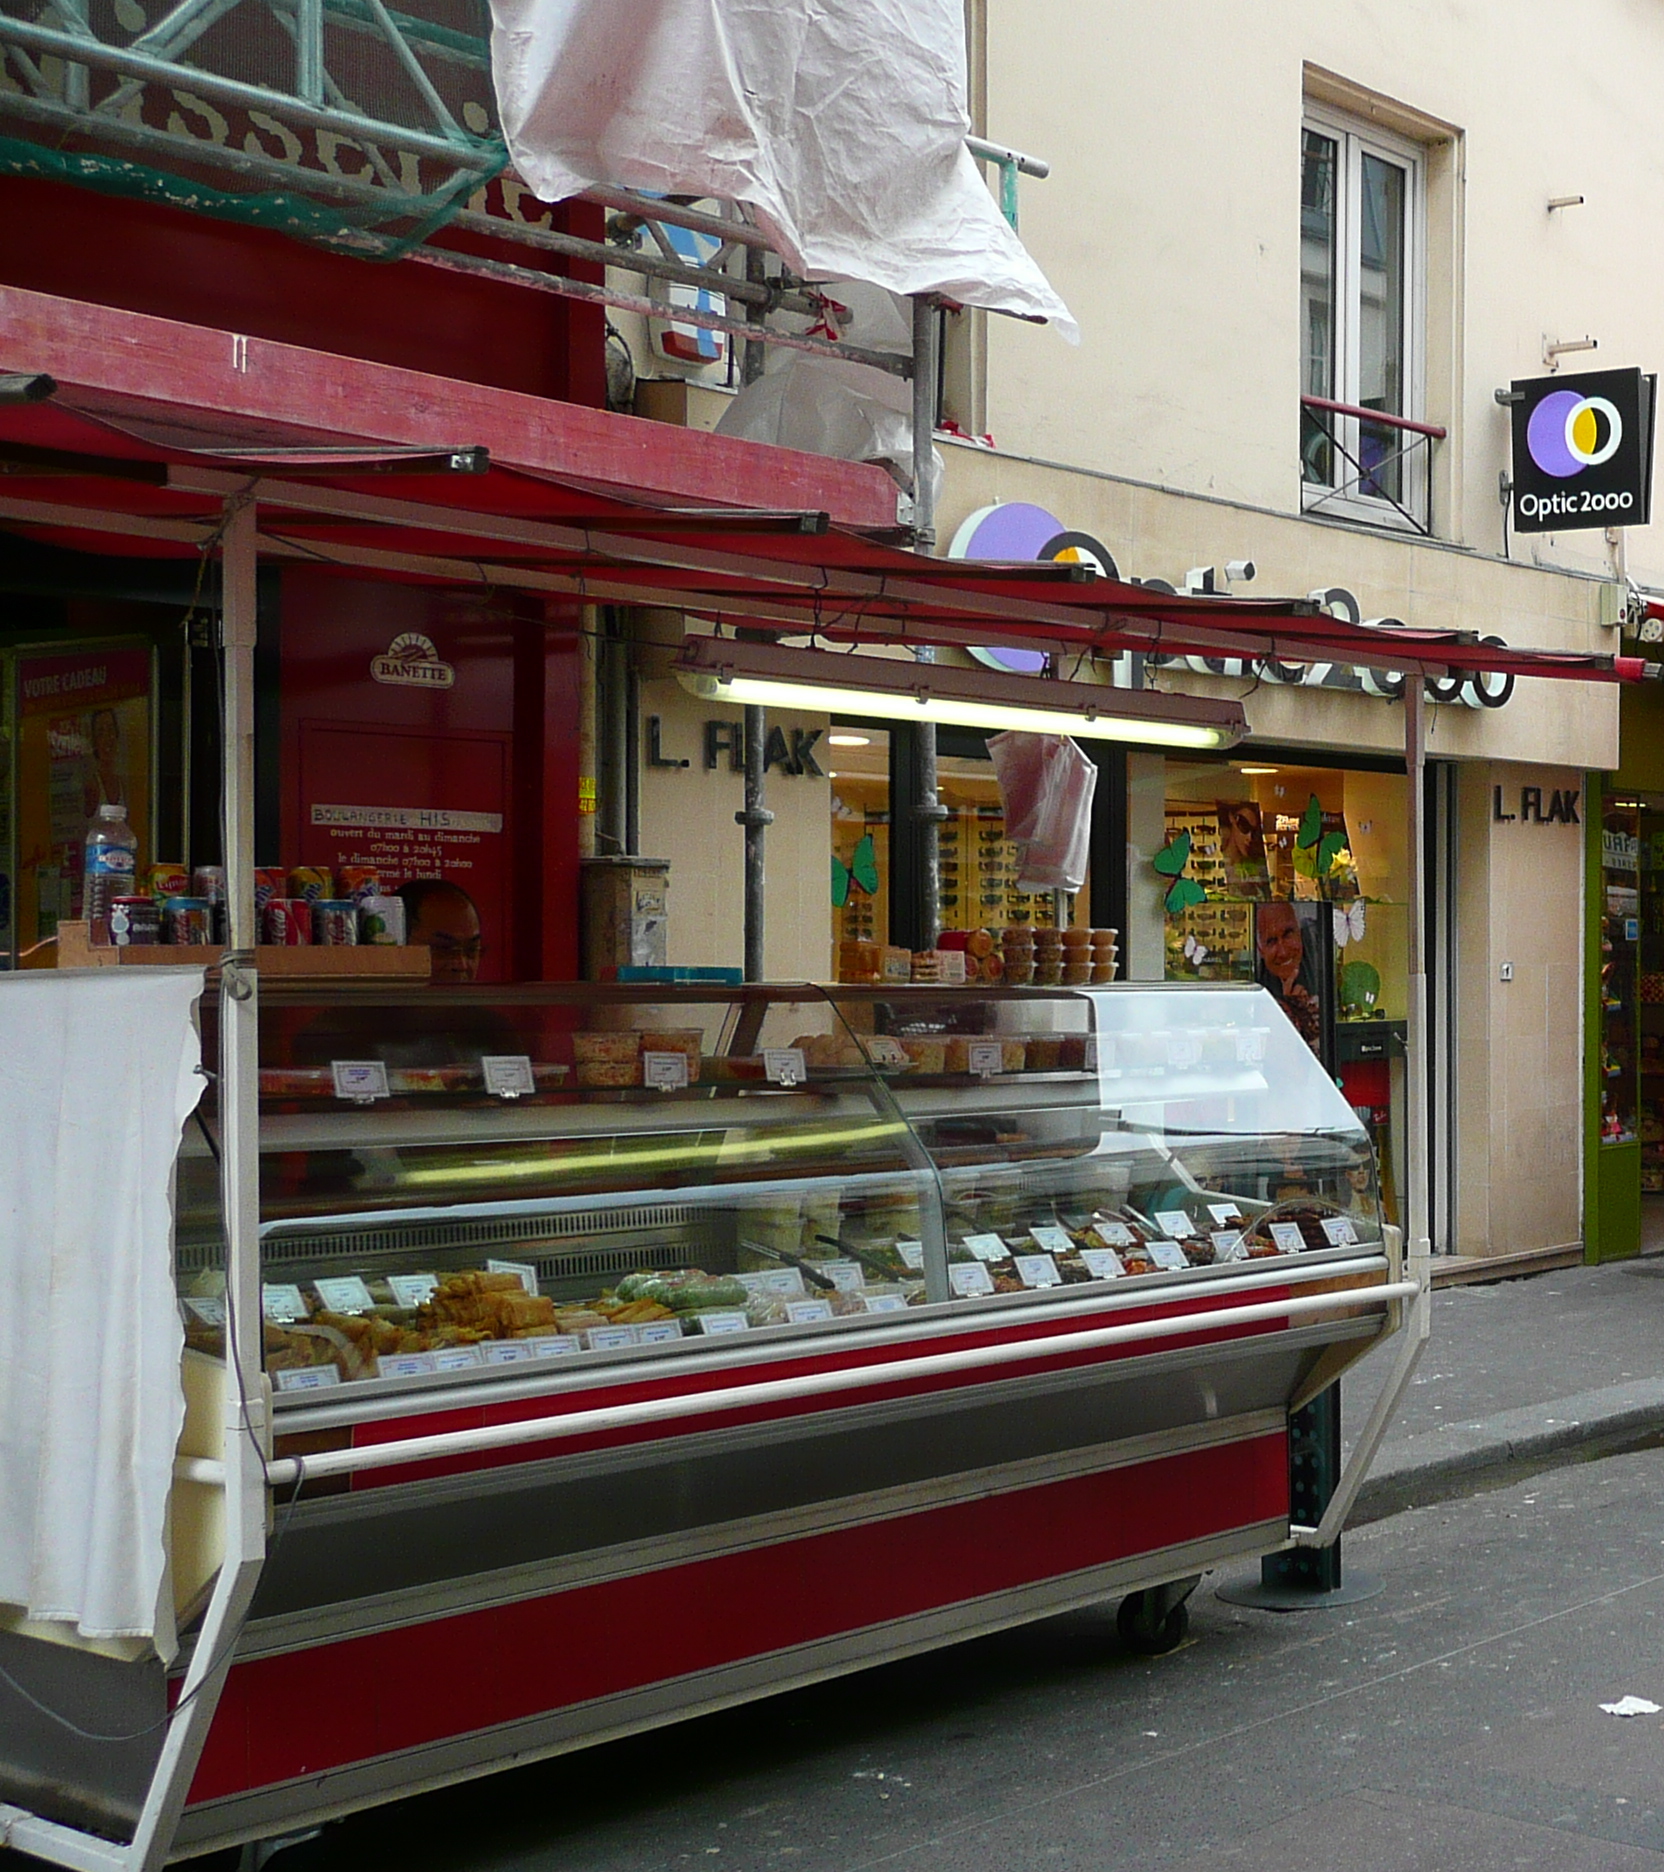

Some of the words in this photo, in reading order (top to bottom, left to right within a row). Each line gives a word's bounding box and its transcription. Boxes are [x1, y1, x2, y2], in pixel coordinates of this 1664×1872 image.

[1520, 490, 1578, 522] Optic
[1580, 491, 1633, 511] 2000
[62, 665, 107, 692] CADEAU
[380, 662, 446, 680] BANETTE
[651, 715, 690, 768] L.
[707, 720, 824, 776] FLAK
[1493, 785, 1516, 823] L.
[1521, 787, 1580, 824] FLAK
[314, 809, 407, 825] BOULANGERIE
[330, 828, 363, 839] ouvert
[367, 828, 381, 839] du
[385, 829, 414, 841] mardi
[418, 832, 431, 841] au
[434, 832, 480, 844] dimanche
[337, 852, 347, 863] le
[350, 853, 399, 865] dimanche
[376, 867, 400, 878] ermé
[416, 869, 441, 880] lundi
